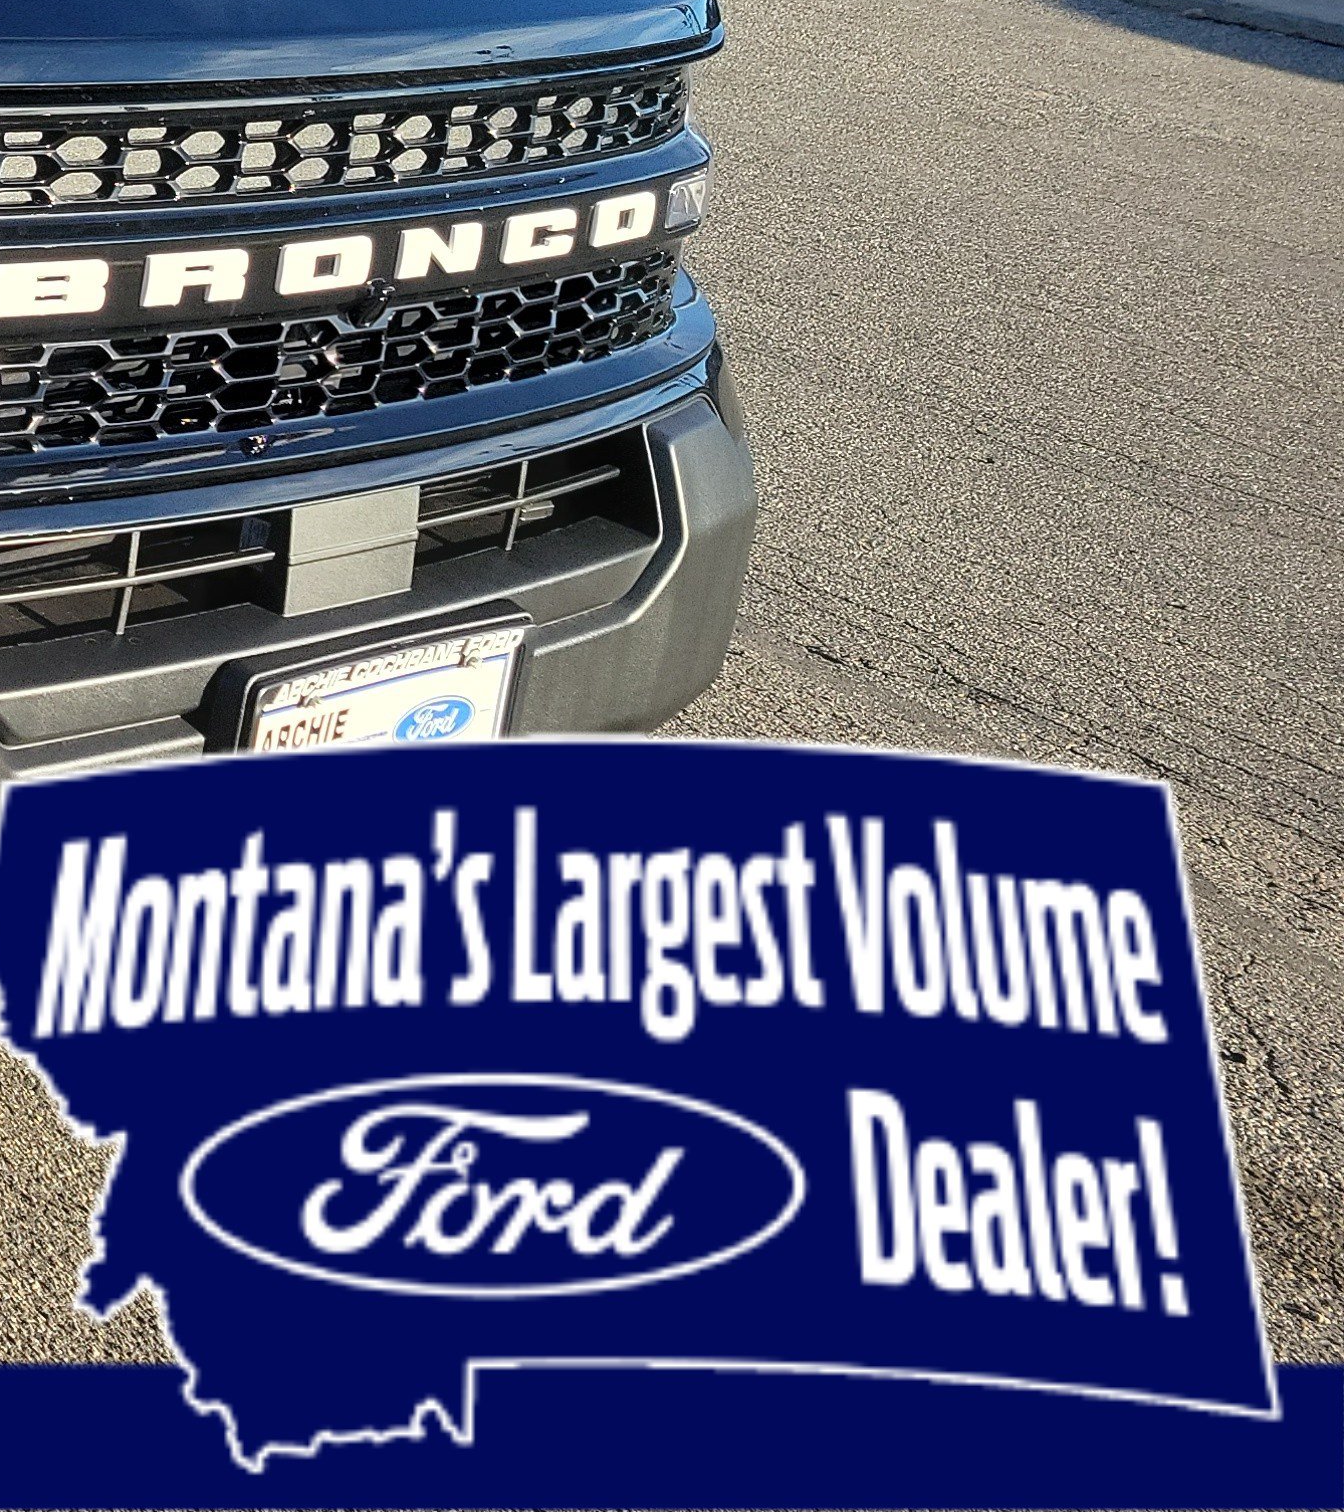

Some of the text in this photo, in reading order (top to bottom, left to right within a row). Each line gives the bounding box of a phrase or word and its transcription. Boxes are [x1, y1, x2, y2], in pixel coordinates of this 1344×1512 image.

[273, 629, 525, 704] ARCHIE COCHRANE FORD
[262, 708, 351, 752] ARCHIE
